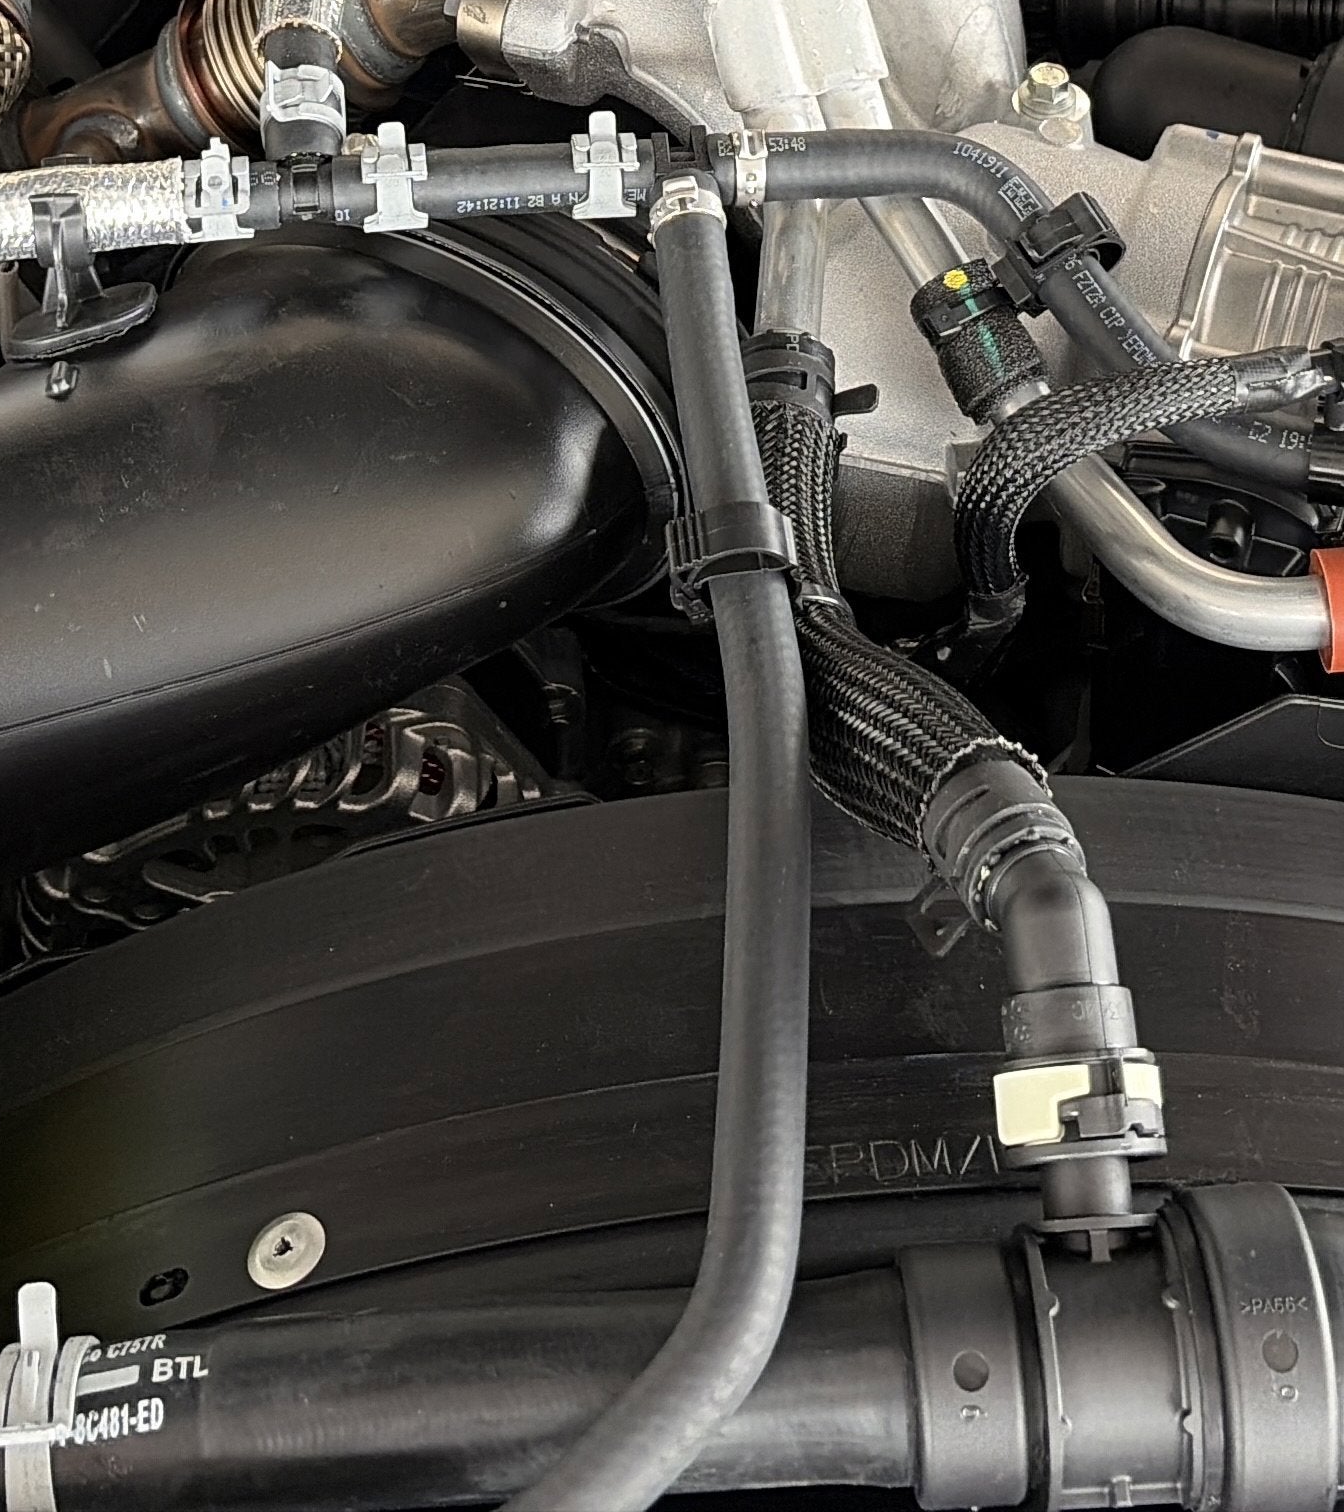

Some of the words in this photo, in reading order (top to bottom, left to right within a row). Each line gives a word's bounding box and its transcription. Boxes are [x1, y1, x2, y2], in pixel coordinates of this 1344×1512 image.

[953, 141, 1009, 178] 1041911
[456, 196, 521, 214] 11:21:42
[107, 1334, 167, 1359] C757R
[152, 1355, 209, 1383] BTL
